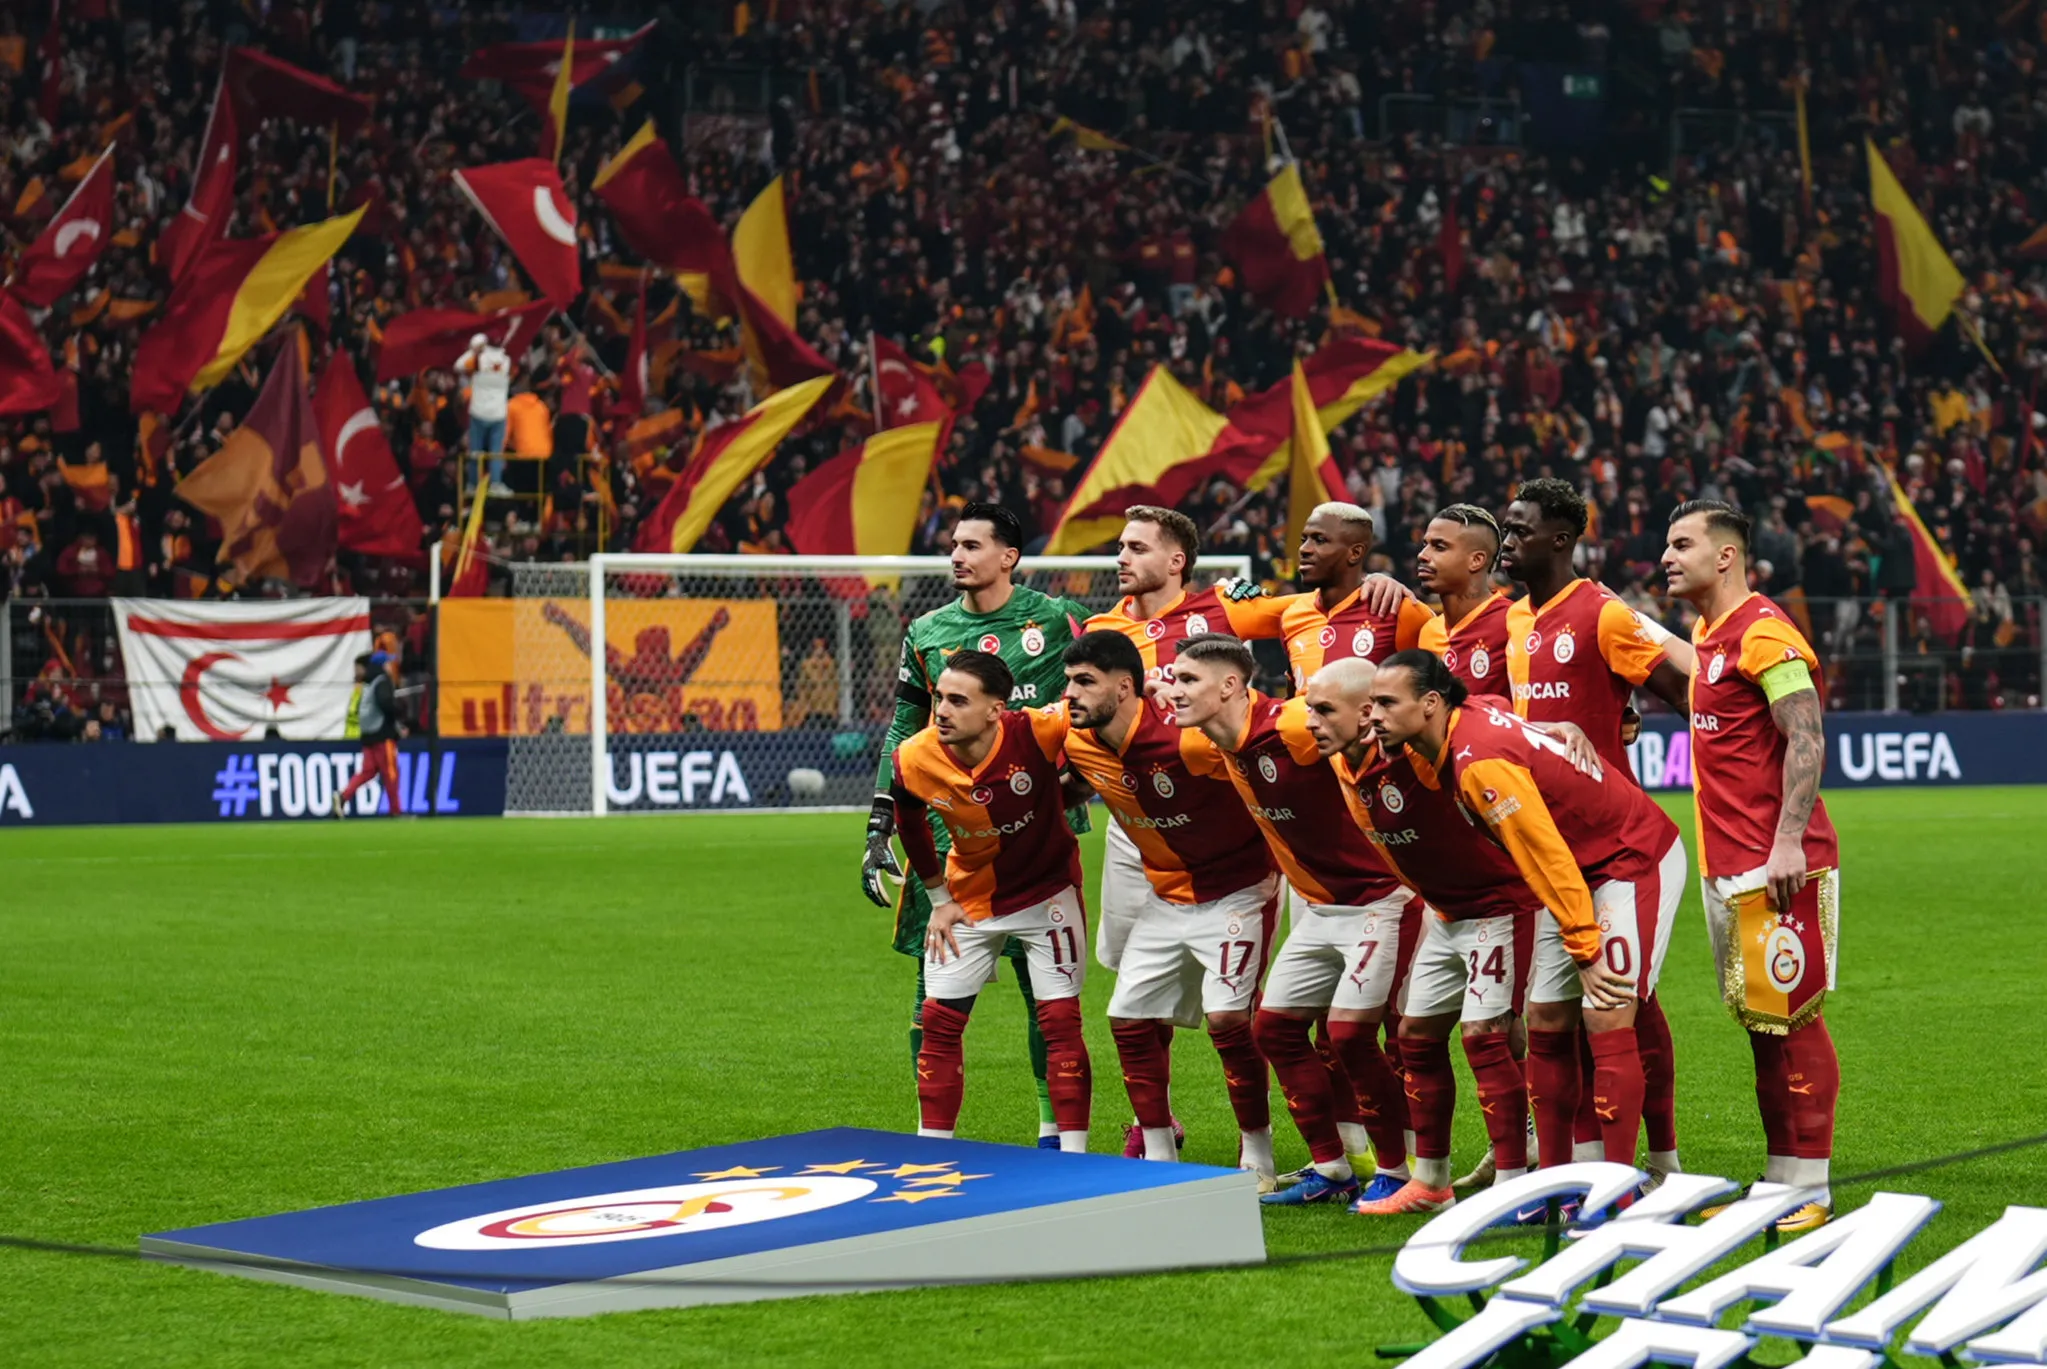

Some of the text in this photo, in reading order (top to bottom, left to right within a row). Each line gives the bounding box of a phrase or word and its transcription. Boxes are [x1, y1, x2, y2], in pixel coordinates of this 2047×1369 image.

[1516, 681, 1570, 699] SOCAR
[1839, 731, 1961, 781] UEFA
[604, 750, 751, 805] UEFA
[974, 810, 1035, 838] SOCAR
[1132, 813, 1192, 829] SOCAR
[1364, 828, 1420, 845] SOCAR
[1045, 926, 1078, 965] 11
[1218, 940, 1255, 976] 17
[1355, 940, 1379, 975] 7
[1605, 936, 1632, 976] 0
